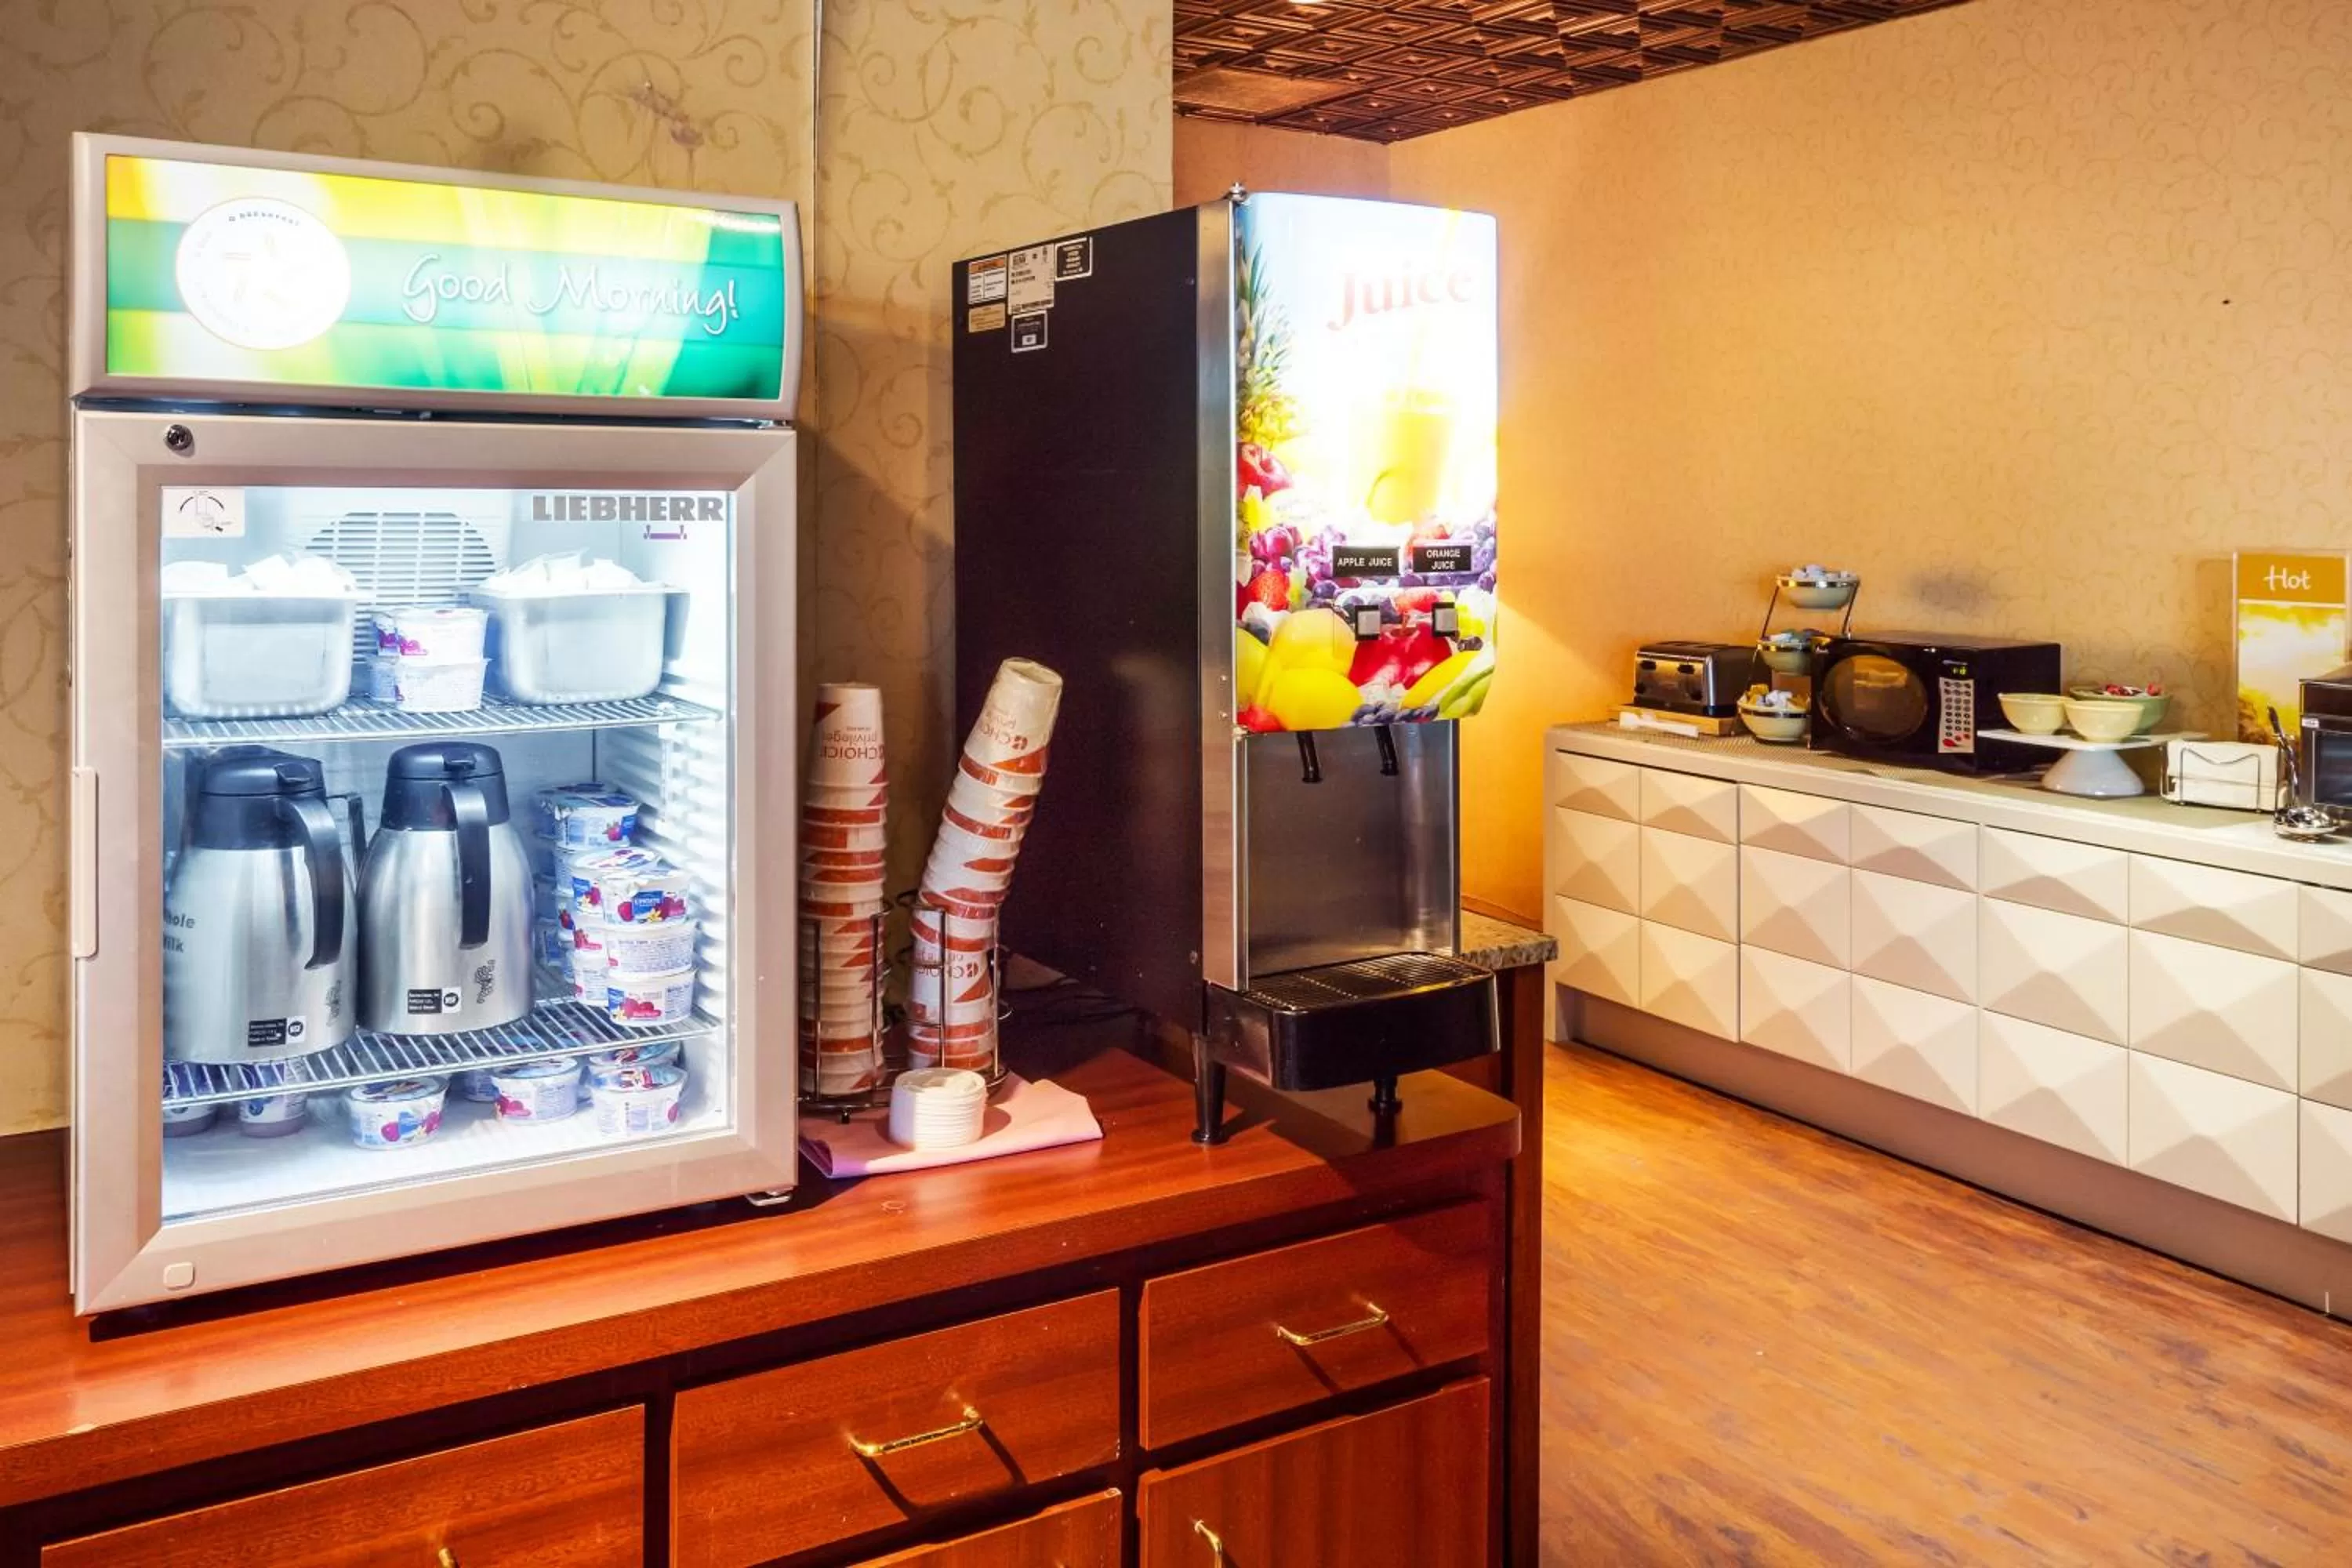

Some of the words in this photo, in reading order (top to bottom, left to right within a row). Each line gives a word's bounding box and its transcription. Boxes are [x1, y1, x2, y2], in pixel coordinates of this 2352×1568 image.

[402, 253, 510, 326] Good
[526, 264, 739, 336] Morning!
[1326, 259, 1473, 332] Juice
[532, 495, 724, 521] LIEBHERR
[1337, 557, 1365, 567] APPLE
[1368, 557, 1392, 567] JUICE
[1426, 549, 1461, 558] ORANGE
[1431, 561, 1455, 570] JUICE
[2263, 564, 2312, 592] Hot
